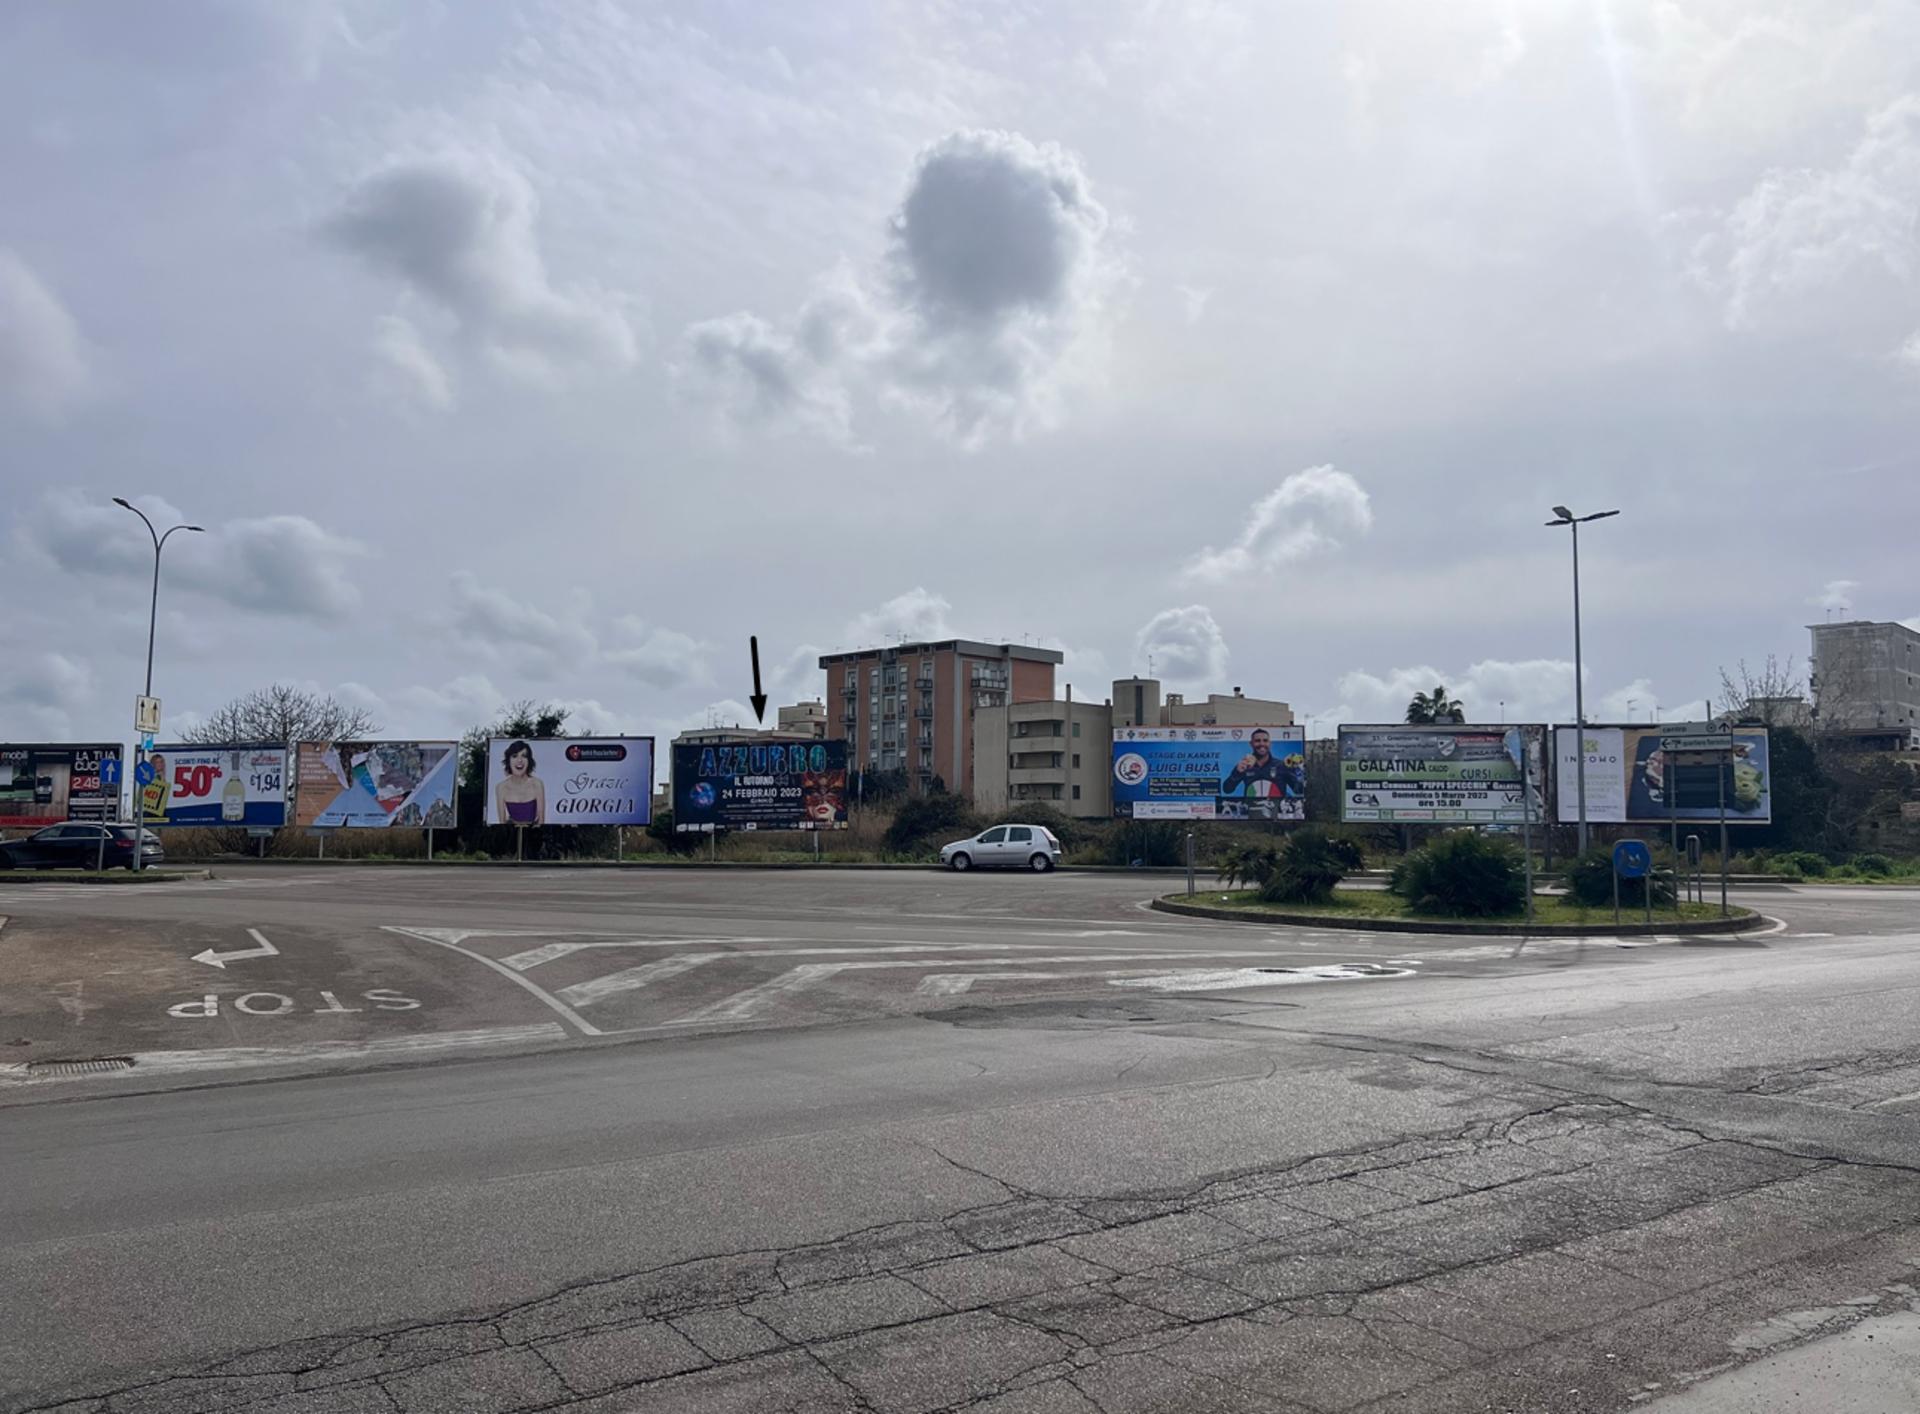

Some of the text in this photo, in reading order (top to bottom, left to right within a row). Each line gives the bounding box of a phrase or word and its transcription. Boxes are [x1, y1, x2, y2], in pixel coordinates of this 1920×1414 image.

[1662, 726, 1687, 734] centro
[76, 751, 116, 761] LA TUA
[197, 757, 211, 765] FINO
[698, 744, 827, 777] AZZURRO
[1150, 751, 1221, 759] STAGE DI KARATE
[1149, 763, 1182, 773] LUIGI
[1358, 759, 1428, 772] GALATINA
[1428, 764, 1449, 772] CALCIO
[1460, 767, 1492, 780] CURSI
[73, 777, 101, 789] 2.49
[173, 765, 222, 798] 50%
[564, 772, 629, 795] Grazie
[722, 786, 803, 800] 24 FEBBRAIO 2023
[1391, 791, 1433, 799] Domenica
[1434, 791, 1440, 799] 5
[1441, 791, 1465, 799] Marzo
[556, 798, 634, 814] GIORGIA
[1436, 799, 1462, 807] 15.00
[166, 988, 423, 1018] STOP
